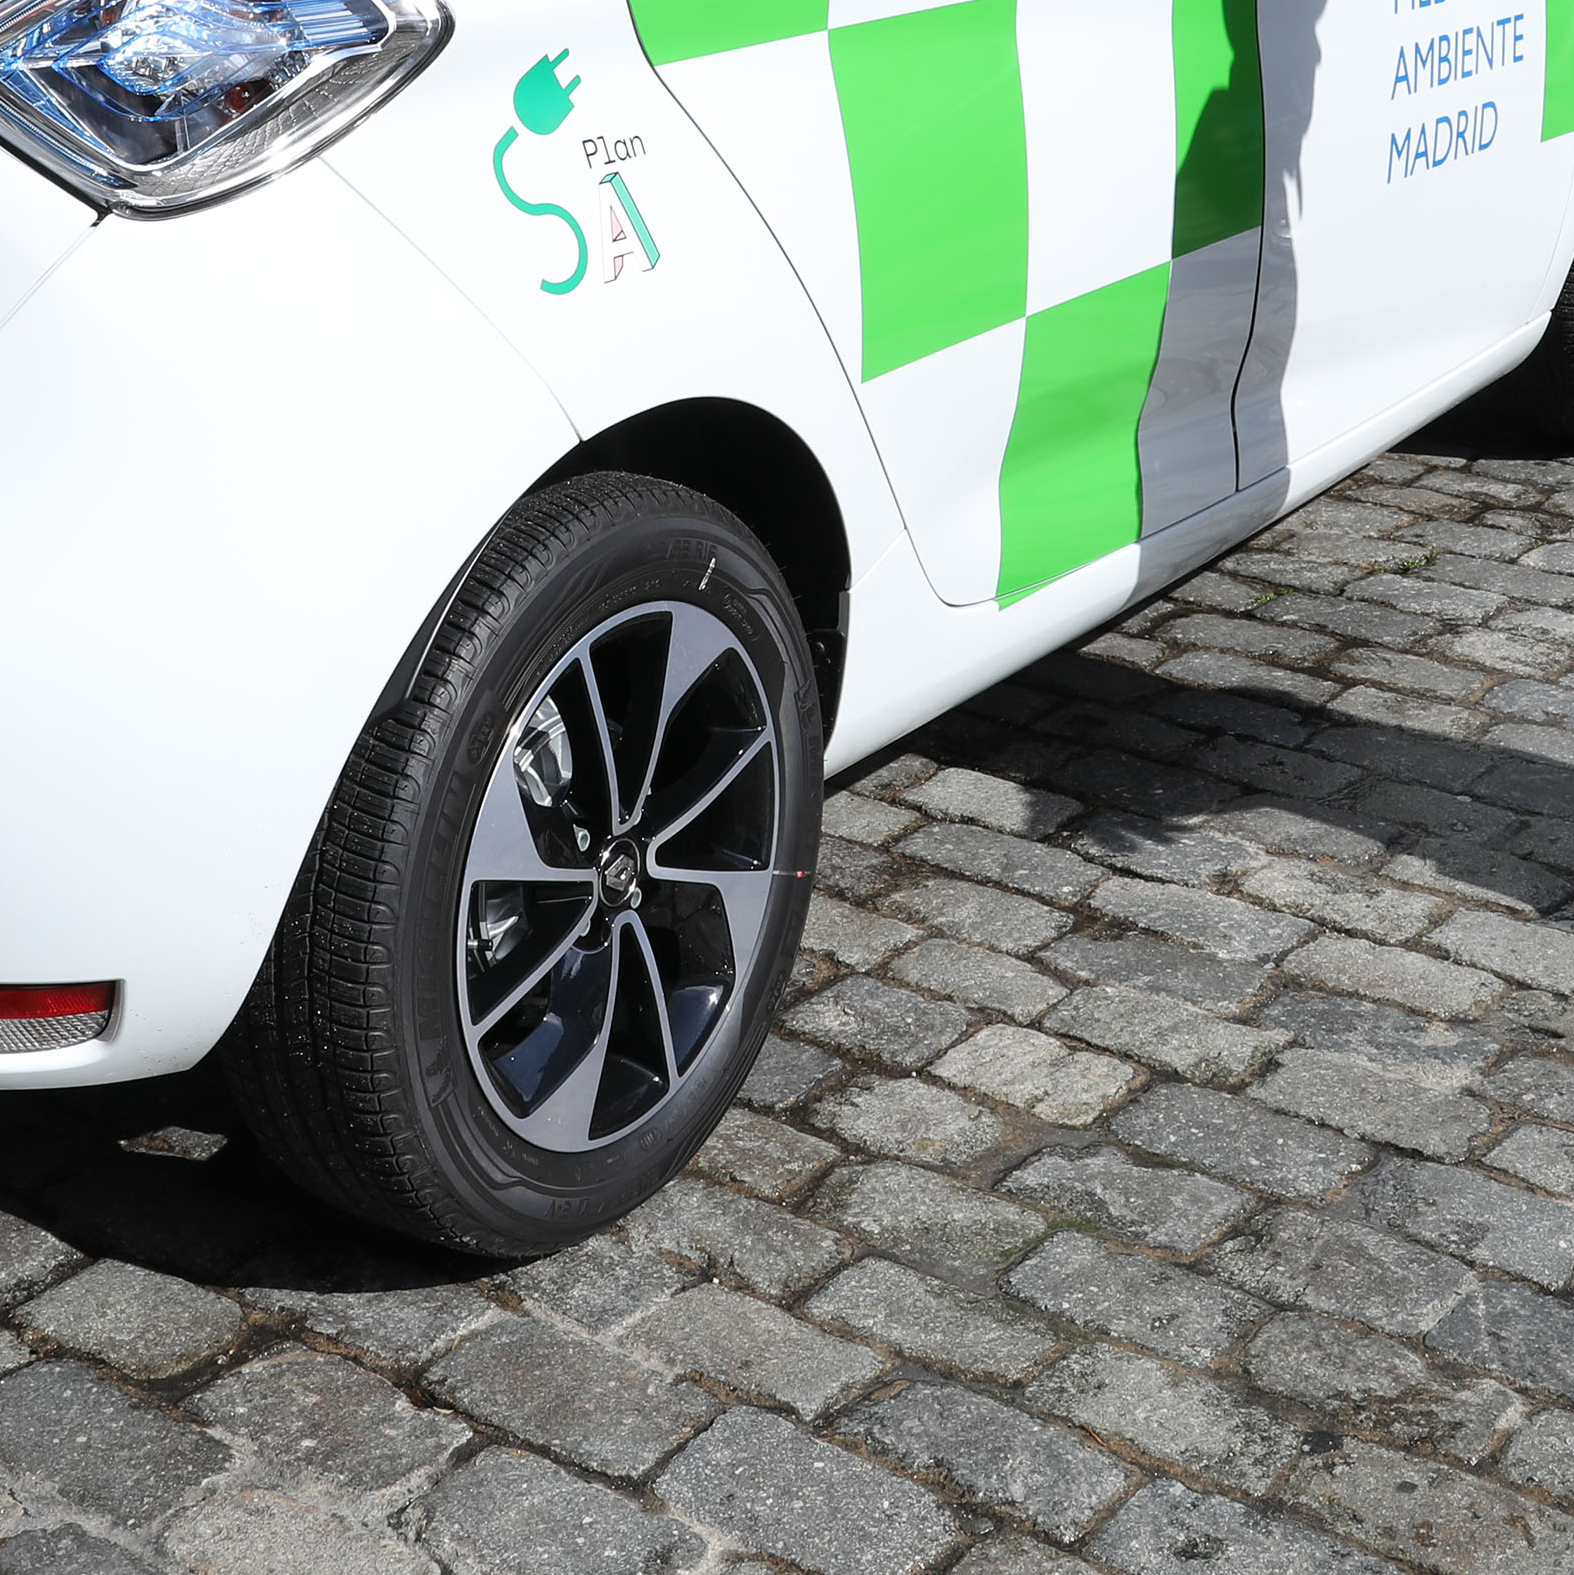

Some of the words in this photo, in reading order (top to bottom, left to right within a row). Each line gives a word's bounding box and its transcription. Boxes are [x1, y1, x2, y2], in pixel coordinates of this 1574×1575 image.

[1391, 13, 1524, 100] AMBIENTE
[582, 135, 646, 169] Plan
[1387, 101, 1498, 184] MADRID
